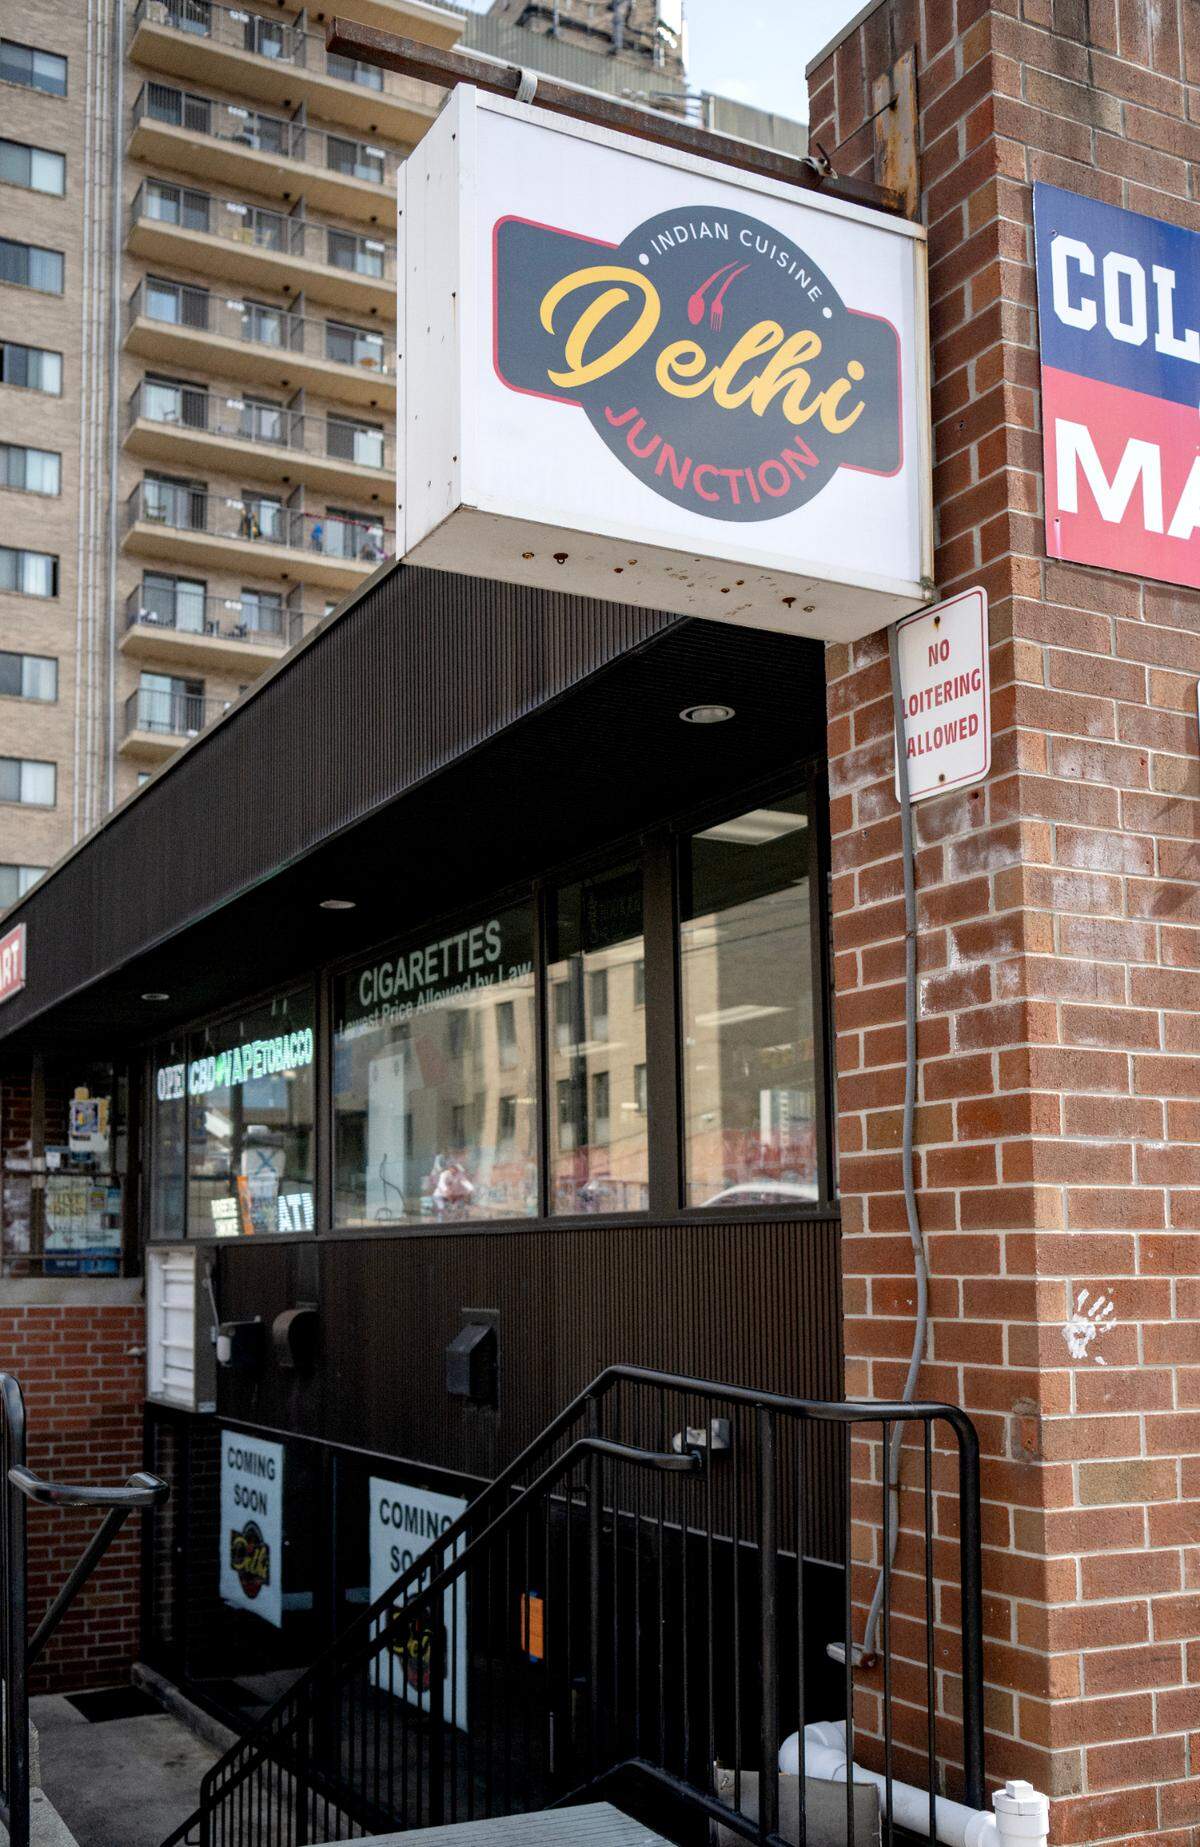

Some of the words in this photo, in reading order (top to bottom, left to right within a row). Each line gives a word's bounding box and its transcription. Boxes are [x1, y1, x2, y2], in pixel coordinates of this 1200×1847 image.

[651, 221, 729, 255] INDIAN
[739, 229, 823, 302] CUISINE
[539, 265, 865, 434] Delhi
[604, 406, 821, 505] JUNCTION
[928, 639, 950, 667] NO
[907, 713, 979, 759] ALLOWED
[359, 920, 501, 1006] CIGARETTES
[382, 998, 413, 1026] Price
[416, 975, 472, 1015] Allowed
[475, 971, 494, 993] by
[498, 961, 532, 986] Law
[189, 1056, 216, 1095] CBD
[221, 1040, 263, 1087] VAPE
[261, 1028, 314, 1073] TOBACCO
[227, 1447, 275, 1480] COMING
[234, 1484, 267, 1515] SOON
